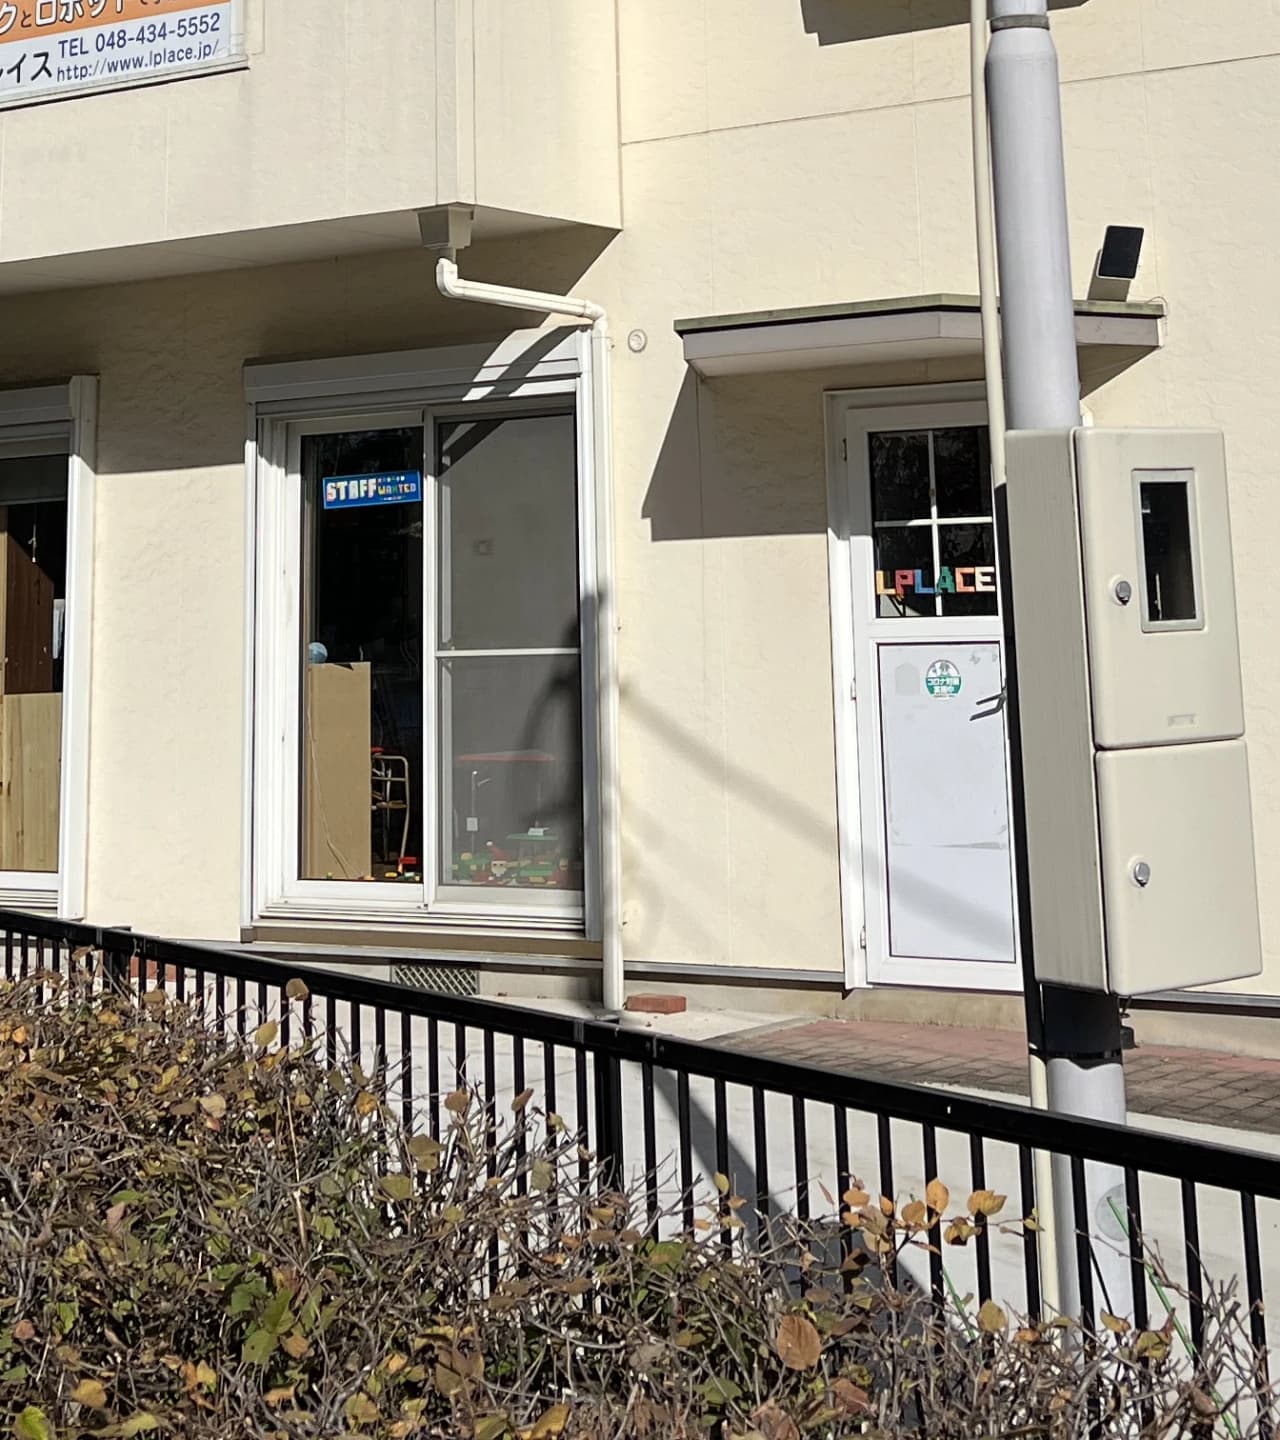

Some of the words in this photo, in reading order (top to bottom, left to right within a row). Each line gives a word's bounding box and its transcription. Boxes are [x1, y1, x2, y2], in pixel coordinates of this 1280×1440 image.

[58, 37, 89, 58] TEL
[95, 12, 221, 53] 048-434-5552
[56, 39, 219, 82] http://www.lplace.jp/
[326, 478, 377, 502] STAFF
[876, 566, 996, 599] LPLACE
